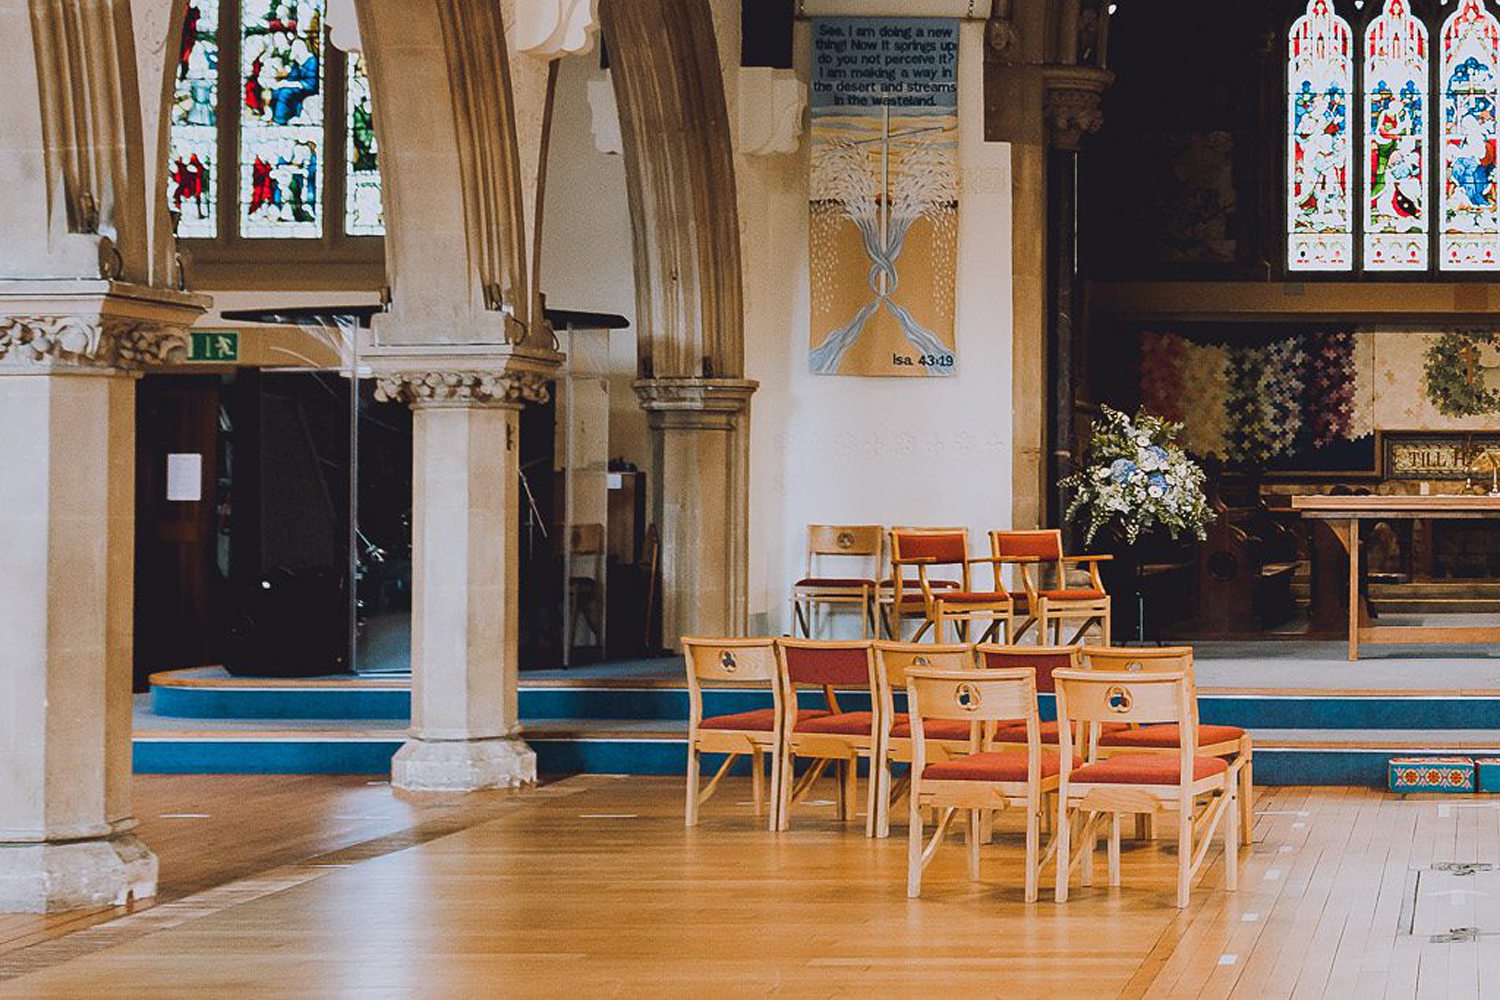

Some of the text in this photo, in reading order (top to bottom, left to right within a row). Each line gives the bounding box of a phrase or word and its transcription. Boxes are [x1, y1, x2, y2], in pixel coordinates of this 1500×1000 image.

[856, 27, 876, 37] am
[879, 25, 913, 40] doing
[916, 27, 925, 37] a
[927, 28, 953, 37] new
[850, 40, 878, 51] Now
[894, 40, 937, 54] springs
[818, 53, 955, 67] do you not perceive it?
[826, 69, 847, 79] am
[850, 66, 896, 81] making
[900, 70, 909, 79] a
[912, 69, 938, 81] way
[941, 67, 953, 79] in
[813, 81, 957, 92] the desert and streams
[833, 95, 844, 106] in
[846, 94, 867, 106] the
[892, 353, 954, 367] Isa. 43:19
[1408, 451, 1447, 468] TILL
